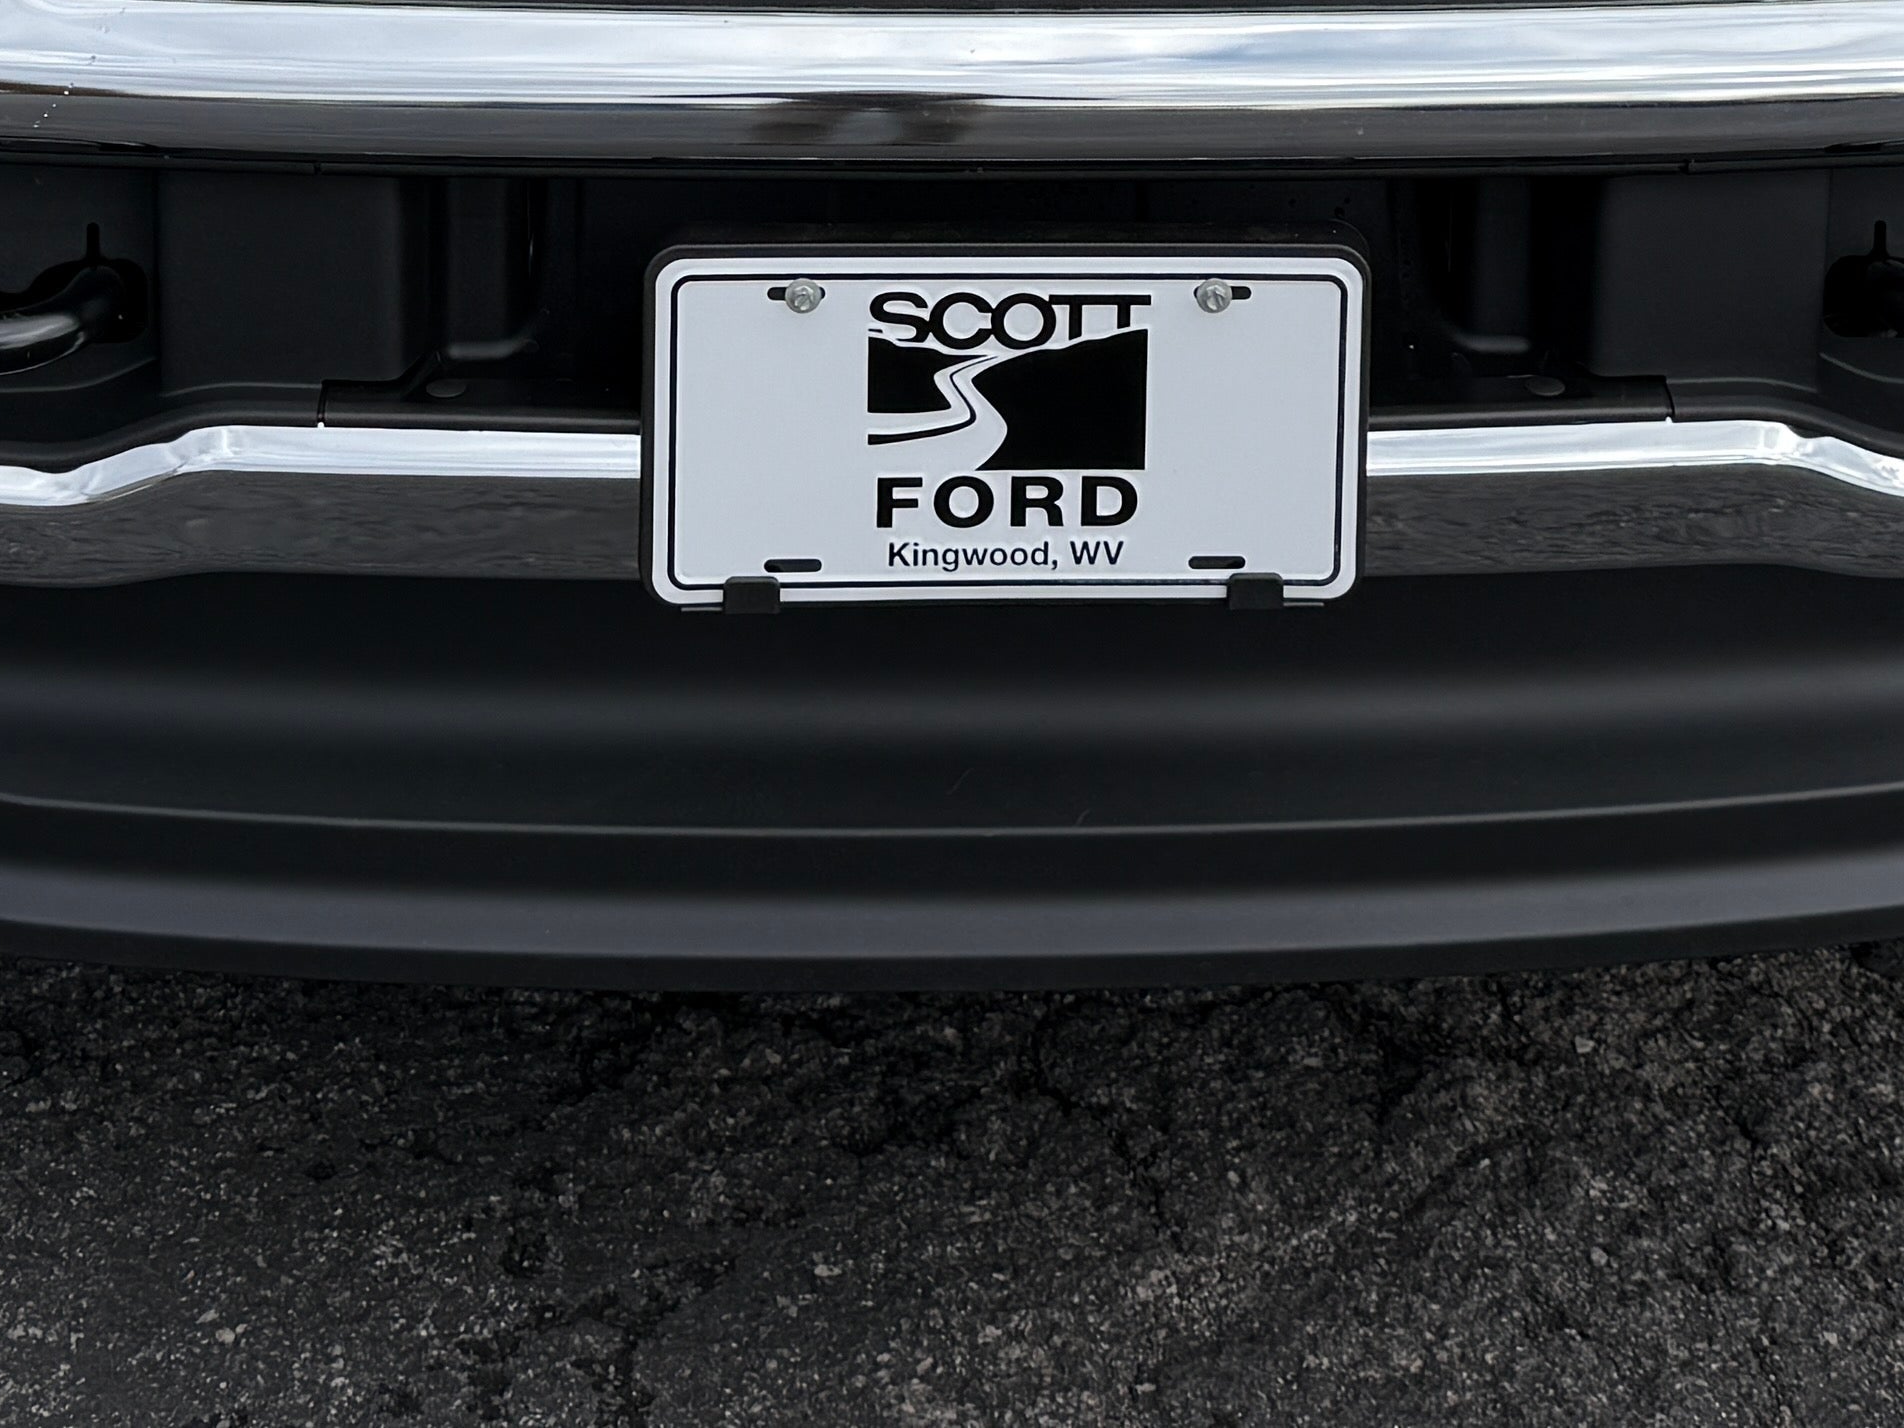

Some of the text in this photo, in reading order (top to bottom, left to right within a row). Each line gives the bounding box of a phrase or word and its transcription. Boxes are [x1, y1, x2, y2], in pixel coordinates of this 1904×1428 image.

[869, 291, 1152, 350] SCOTT
[876, 475, 1138, 528] FORD
[888, 541, 1124, 572] Kingwood, WV
